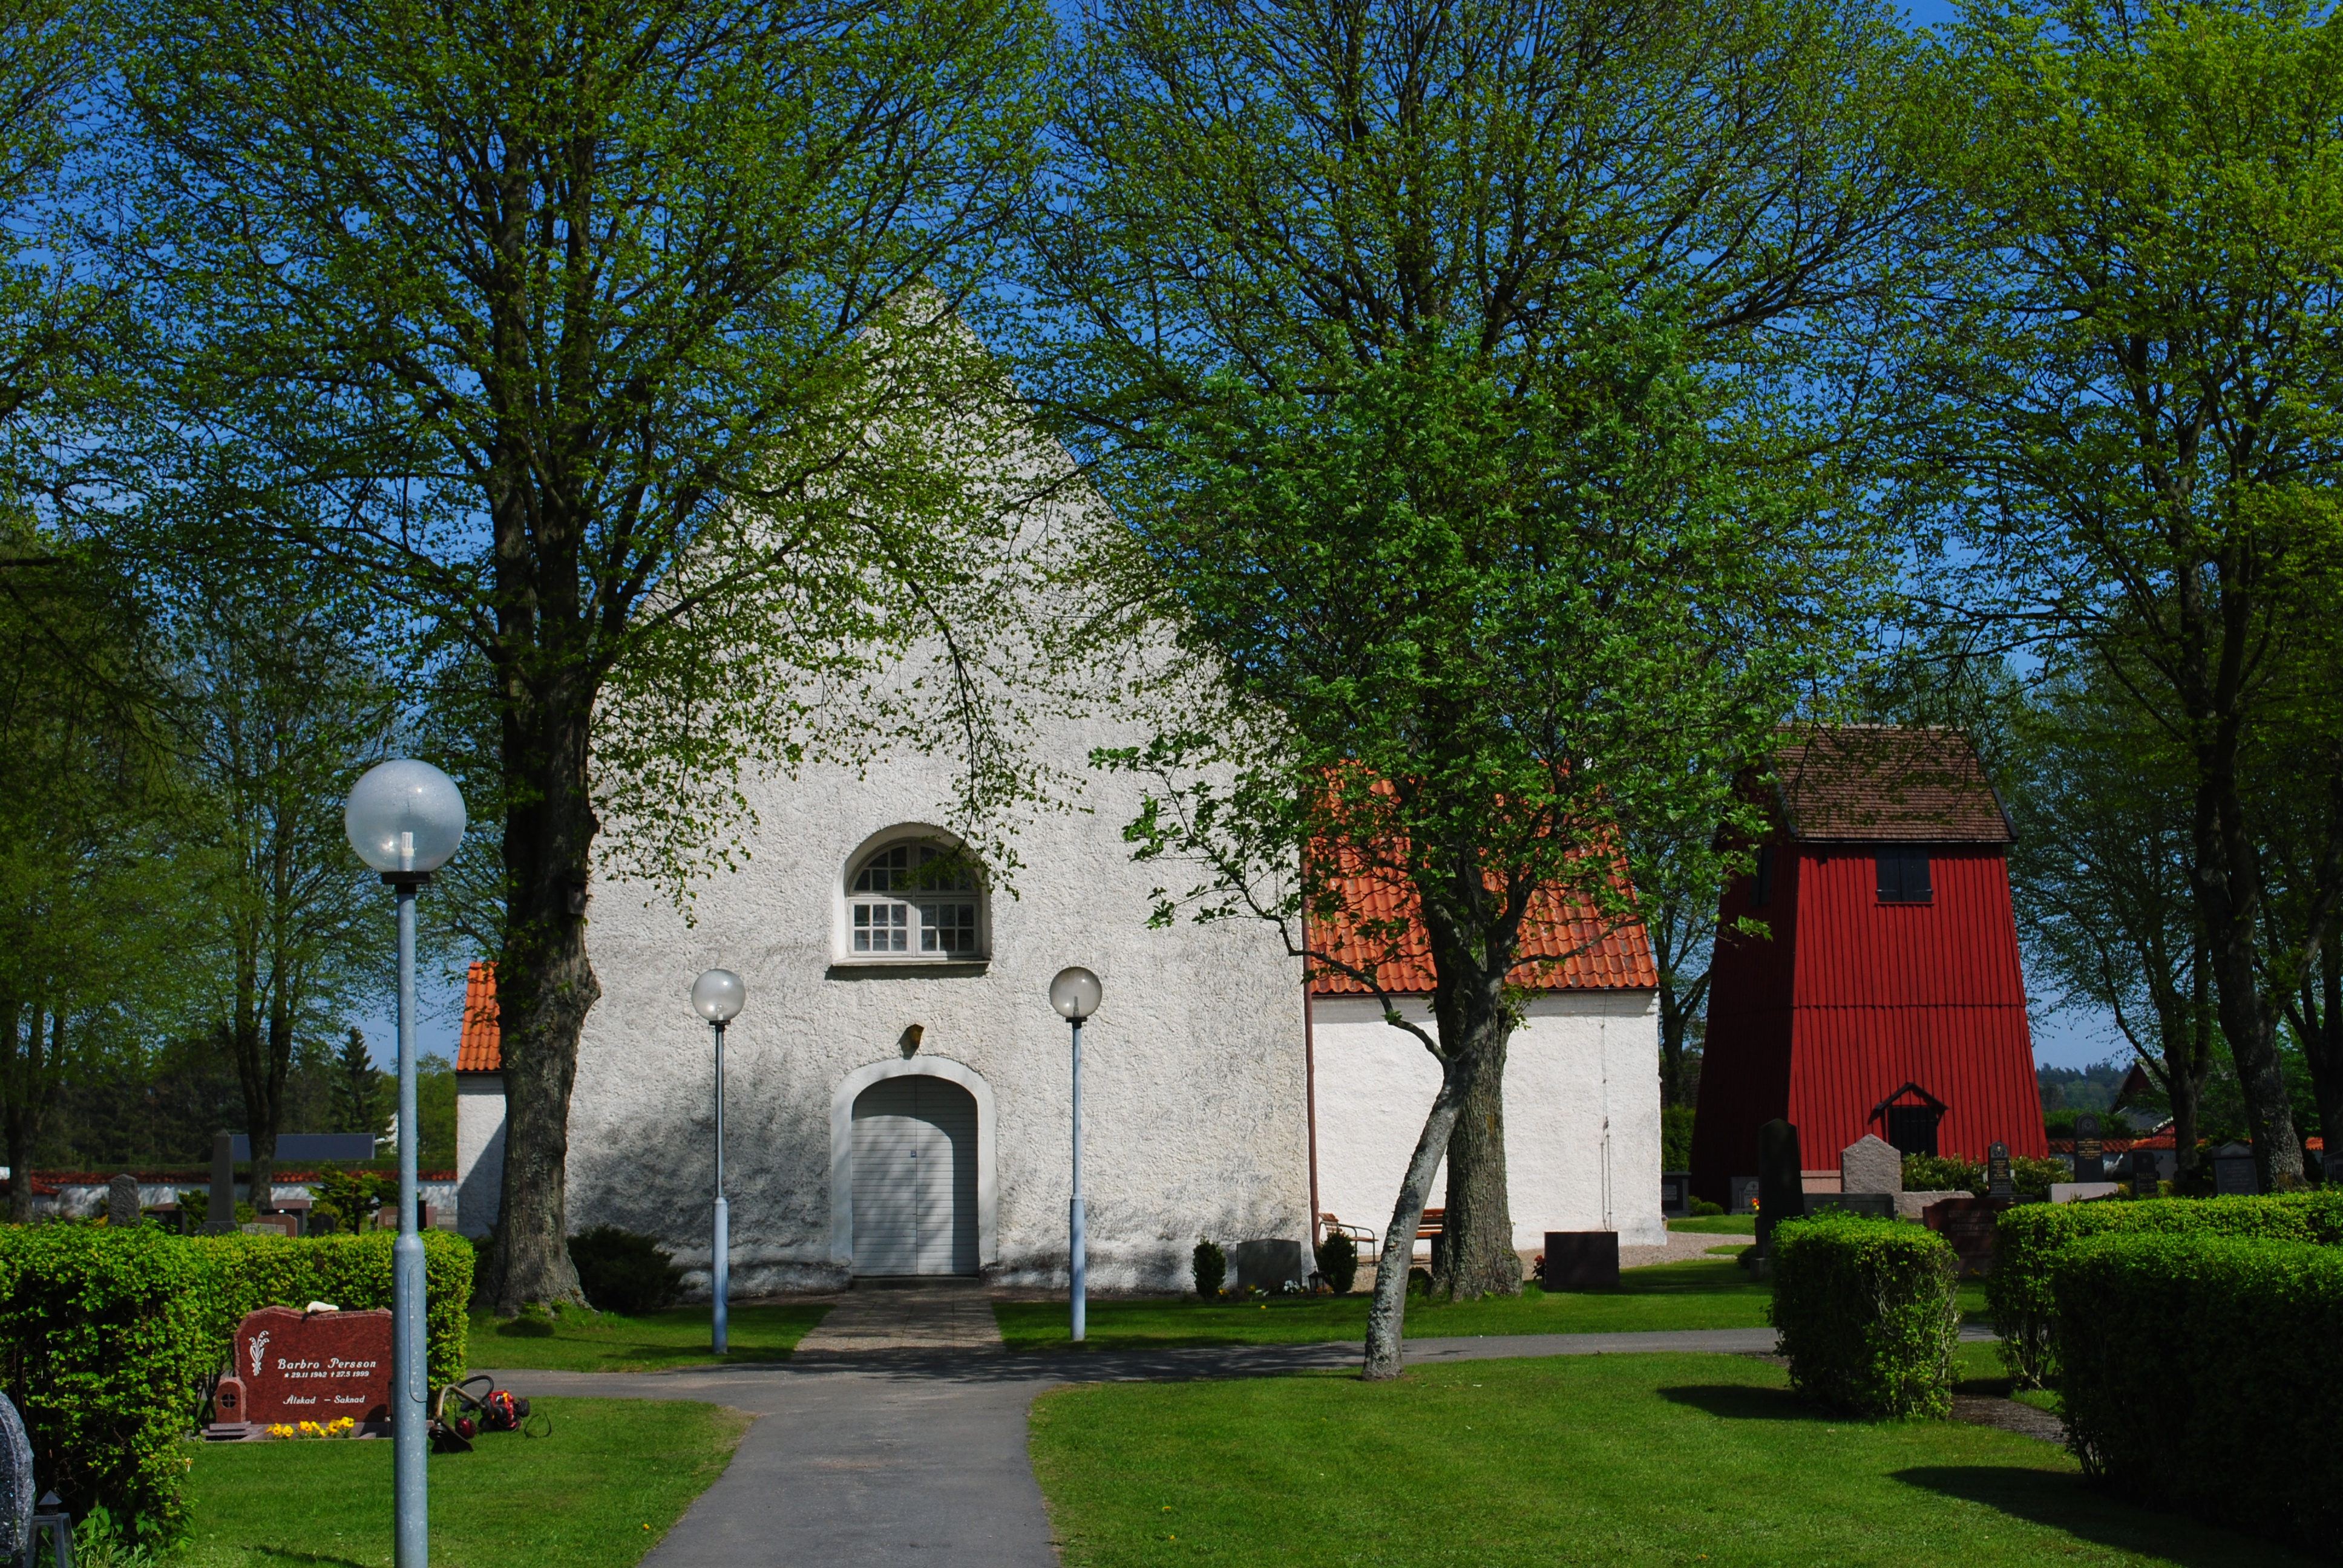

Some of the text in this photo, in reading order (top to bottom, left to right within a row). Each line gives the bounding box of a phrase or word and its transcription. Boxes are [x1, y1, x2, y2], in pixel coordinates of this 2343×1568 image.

[277, 1357, 376, 1370] Barbro Persson
[334, 1394, 365, 1404] Saknad
